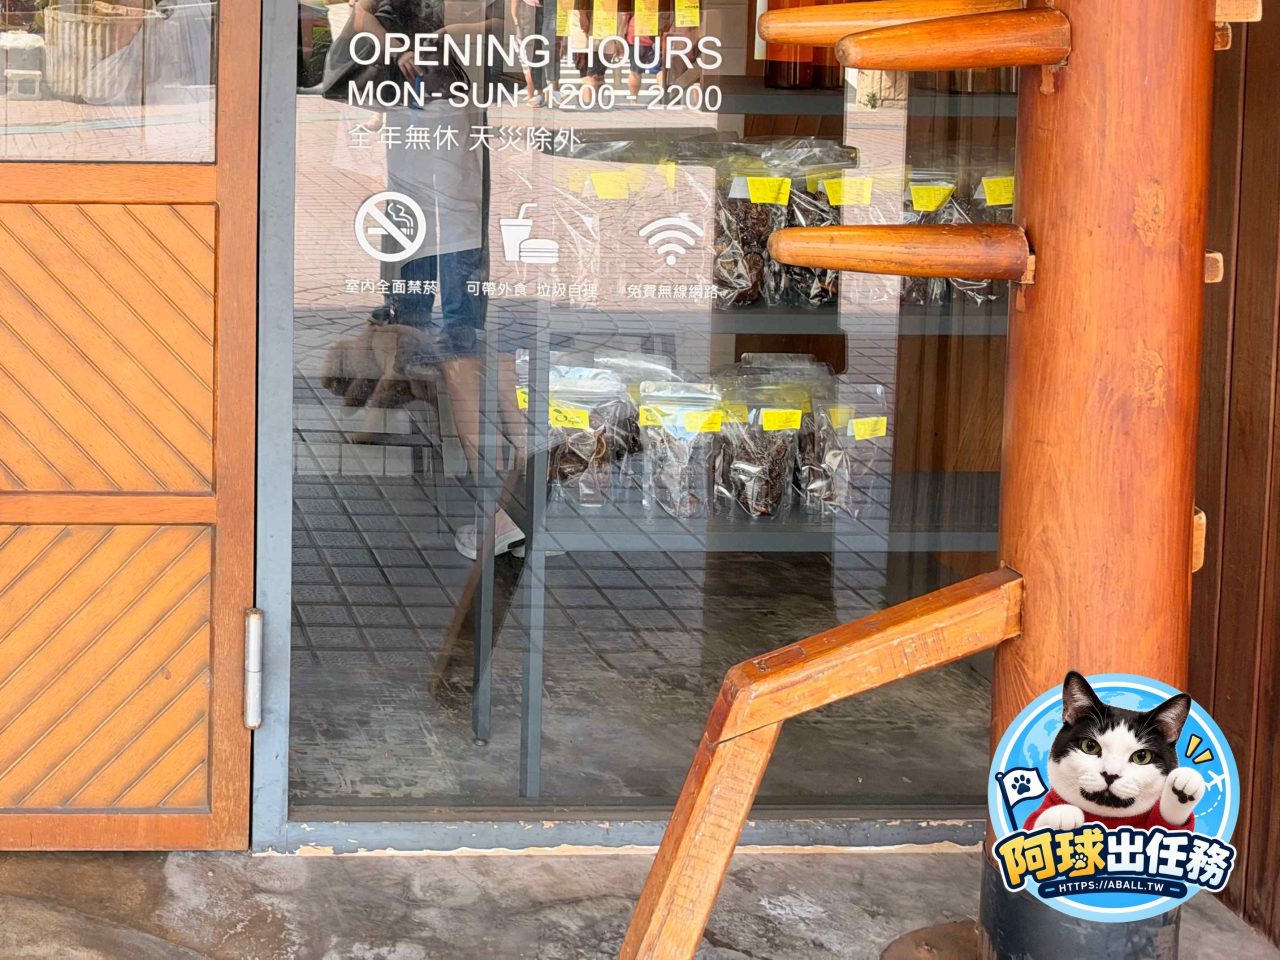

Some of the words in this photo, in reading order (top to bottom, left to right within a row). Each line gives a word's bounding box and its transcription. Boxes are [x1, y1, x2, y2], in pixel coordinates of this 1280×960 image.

[349, 32, 550, 69] OPENING
[567, 34, 723, 70] HOURS
[543, 83, 615, 110] 1200
[647, 85, 722, 110] 2200
[348, 124, 459, 151] 全年無休
[469, 125, 581, 153] 天災除外
[345, 279, 438, 295] 室內全面禁菸
[466, 280, 527, 296] 可帶外食
[537, 283, 598, 298] 垃圾自理
[626, 283, 720, 299] 免費無線網路
